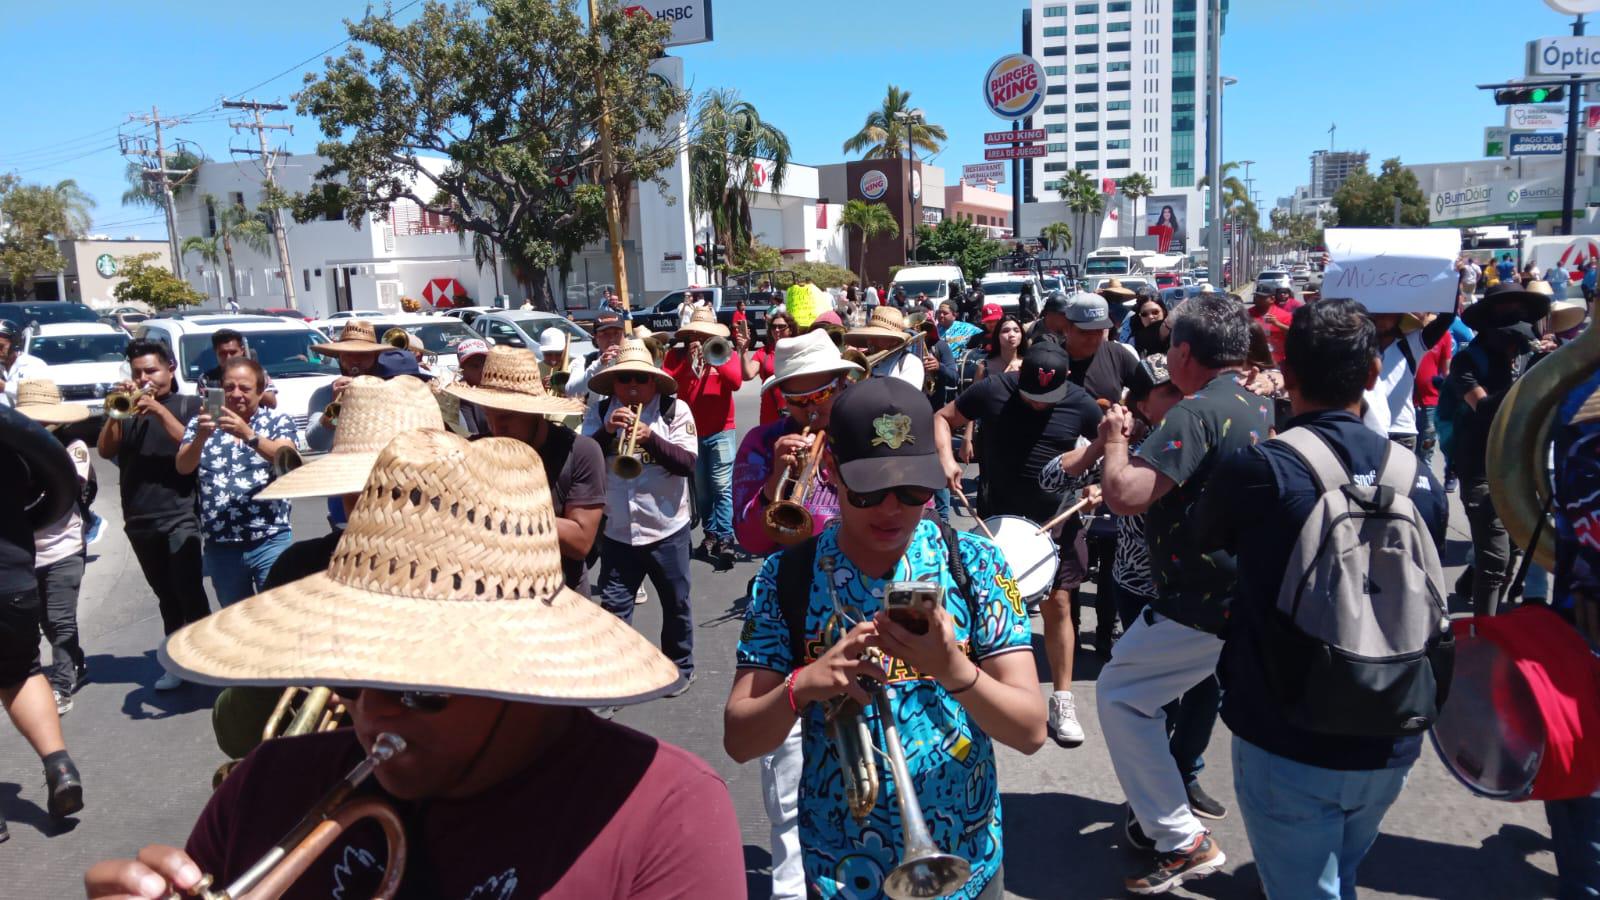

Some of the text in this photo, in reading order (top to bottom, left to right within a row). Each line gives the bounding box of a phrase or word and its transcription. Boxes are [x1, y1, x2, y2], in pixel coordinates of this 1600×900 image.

[656, 5, 693, 21] HSBC
[991, 63, 1035, 92] BURGER
[993, 74, 1038, 107] KING
[987, 130, 1043, 142] AUTO KING
[1006, 149, 1015, 157] DE
[1016, 146, 1043, 157] JUEGOS
[1513, 143, 1562, 152] SERVICIOS
[864, 180, 885, 193] KING
[1083, 308, 1105, 318] VANS
